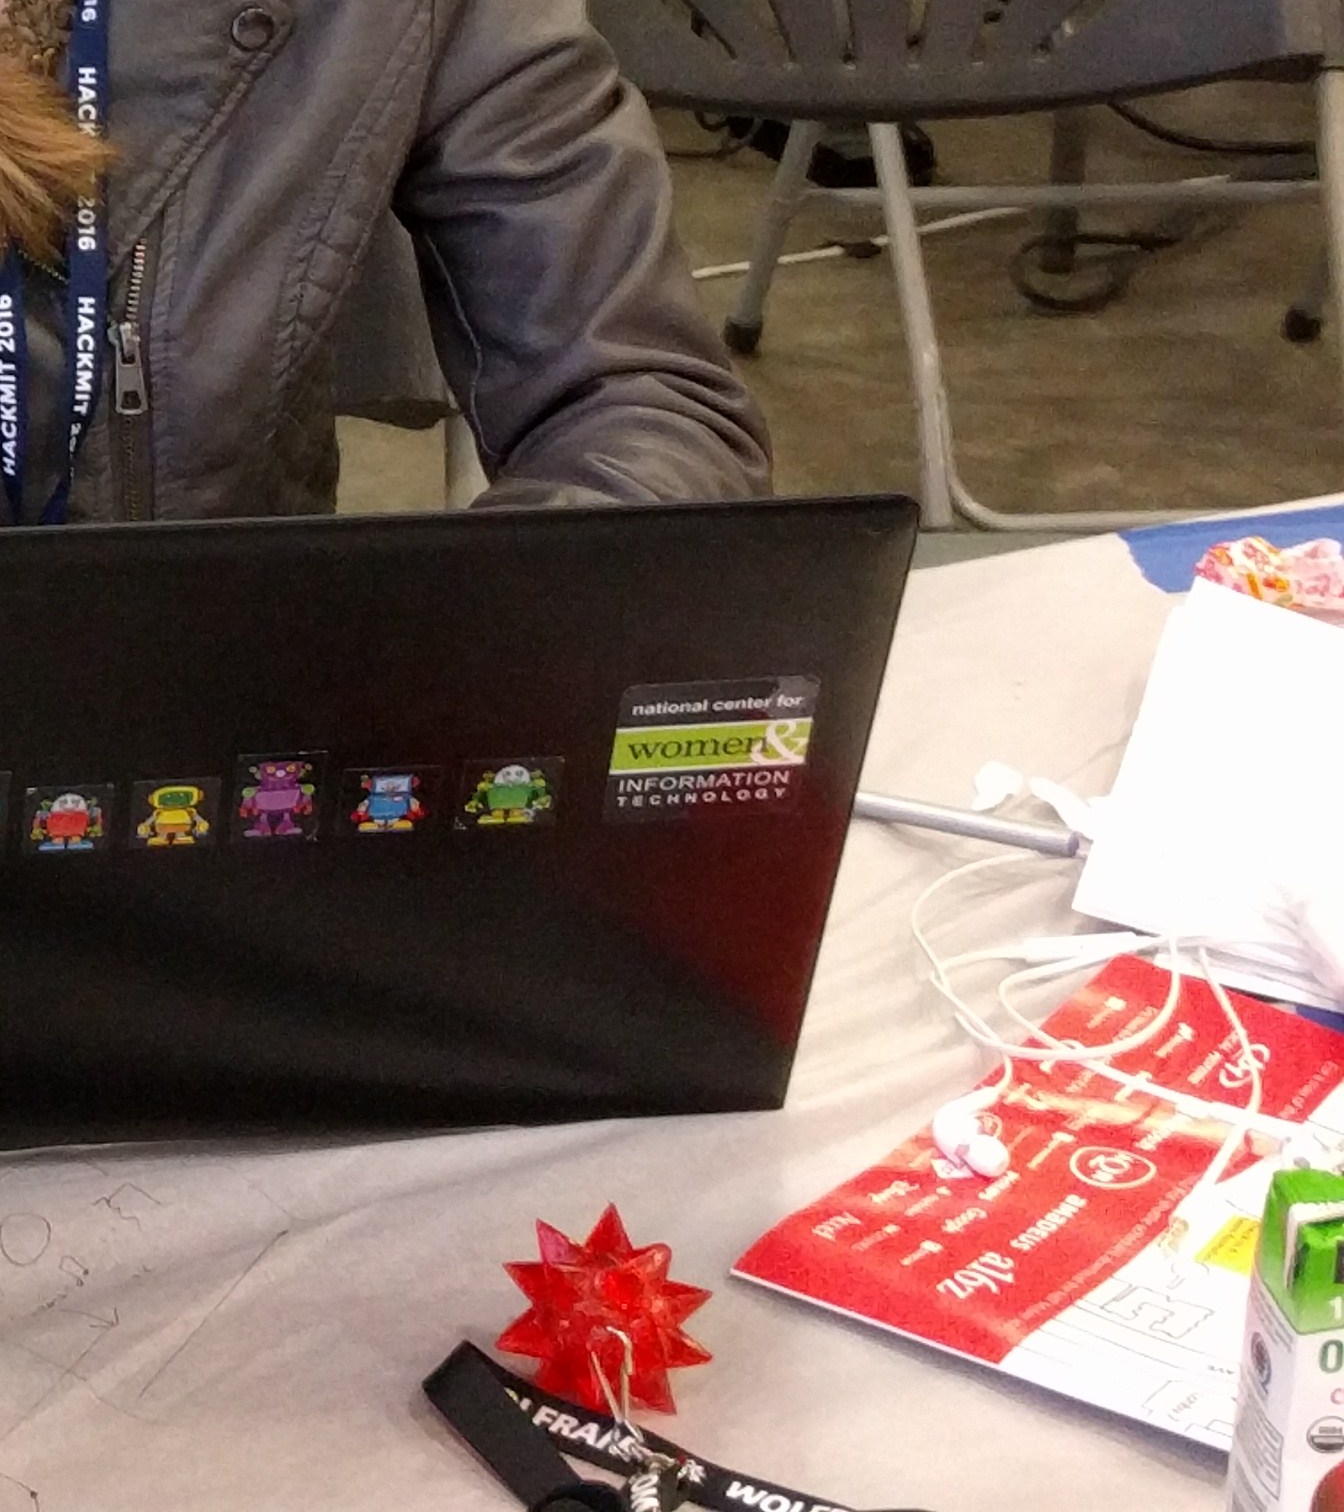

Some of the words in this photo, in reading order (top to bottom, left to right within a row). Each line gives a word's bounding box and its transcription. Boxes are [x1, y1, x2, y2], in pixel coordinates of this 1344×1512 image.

[77, 66, 100, 138] HACK
[76, 194, 96, 252] 2016
[73, 296, 96, 417] HACKMIT
[631, 699, 708, 717] national
[712, 696, 772, 712] center
[777, 693, 804, 709] for
[627, 735, 769, 761] women
[618, 770, 791, 794] INFORMATION
[615, 787, 787, 809] TECHNOLOGY
